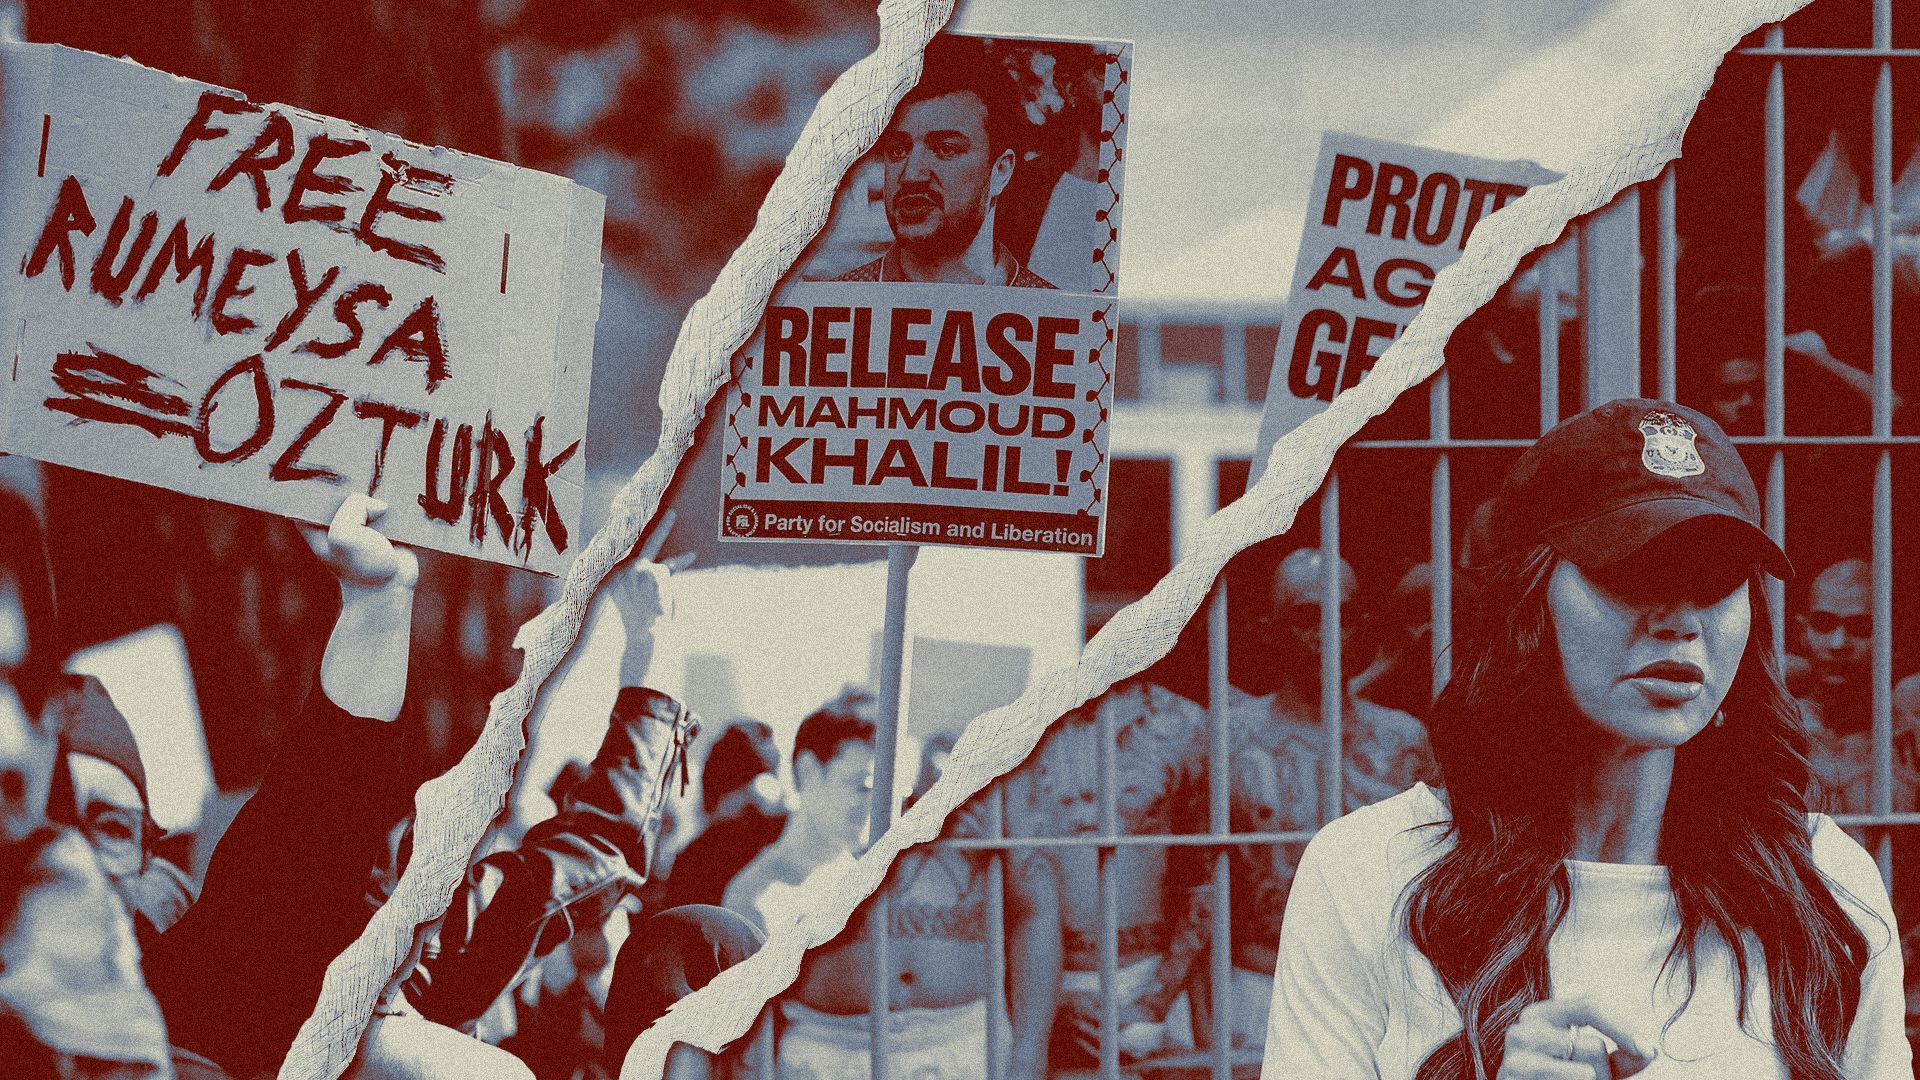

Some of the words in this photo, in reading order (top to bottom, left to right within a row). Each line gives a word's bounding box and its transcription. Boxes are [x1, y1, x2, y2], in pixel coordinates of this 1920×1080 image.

[158, 91, 455, 275] FREE
[20, 175, 453, 395] RUMEYSA
[761, 306, 1080, 399] RELEASE
[1287, 308, 1408, 403] GE
[194, 353, 581, 566] OZTURK
[757, 395, 1076, 439] MAHMOUD
[755, 436, 1073, 497] KHALIL!
[764, 513, 813, 535] Party
[818, 514, 845, 532] for
[850, 515, 940, 535] Socialism
[947, 522, 985, 539] and
[991, 522, 1093, 546] Liberation
